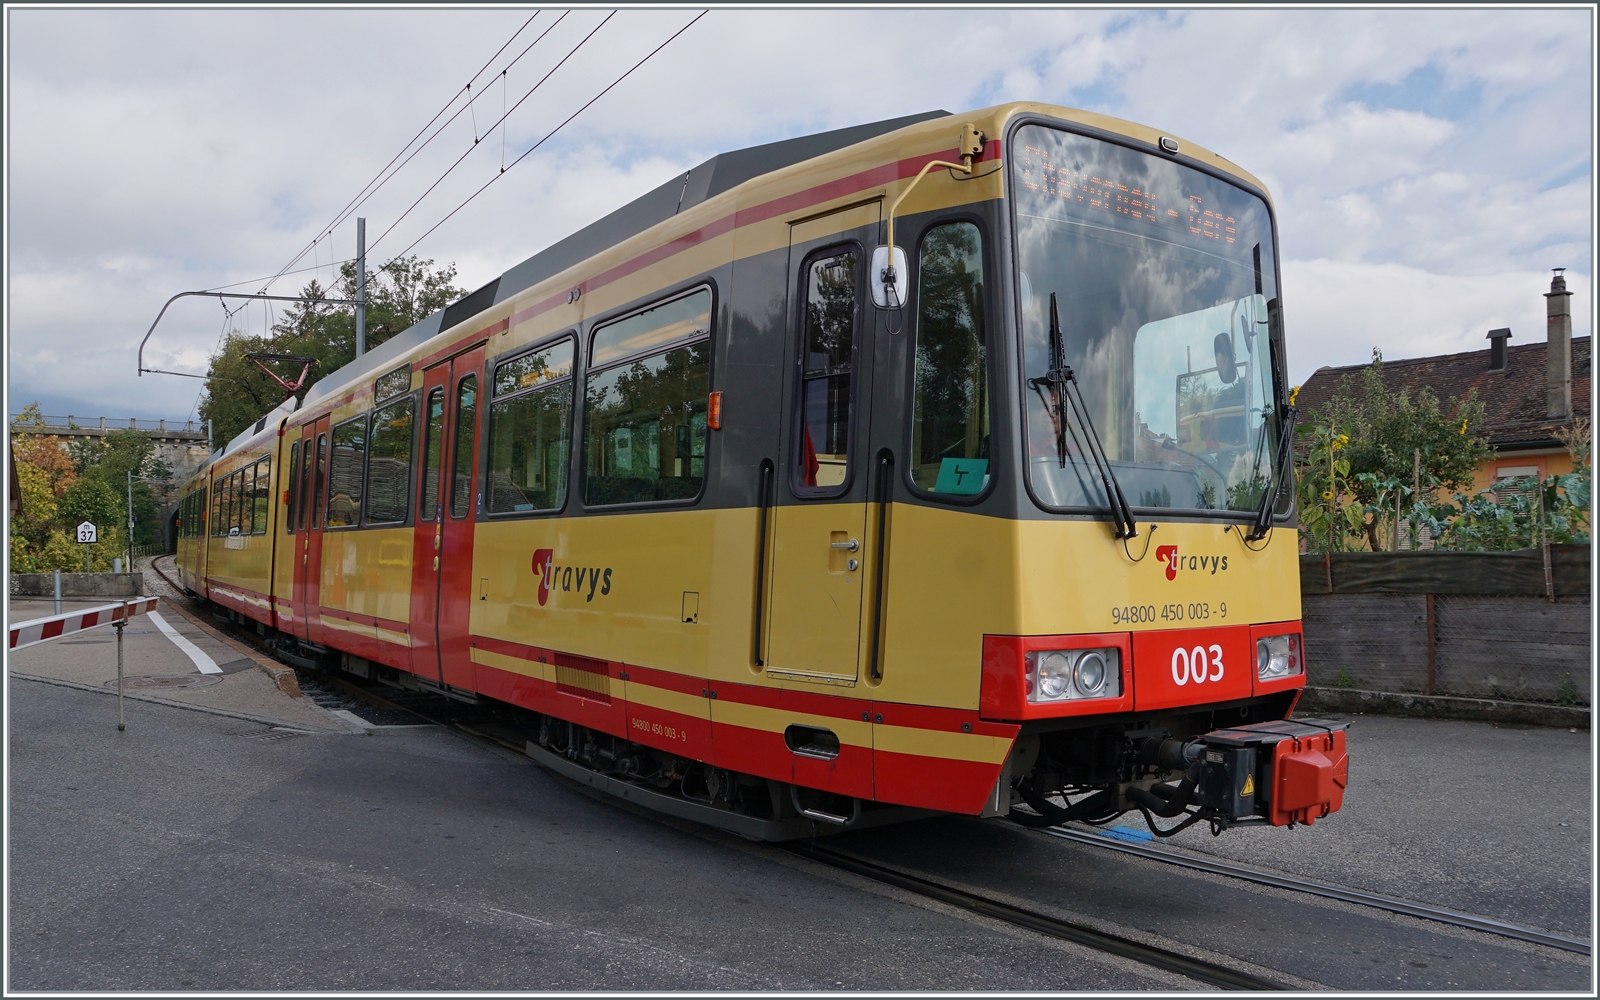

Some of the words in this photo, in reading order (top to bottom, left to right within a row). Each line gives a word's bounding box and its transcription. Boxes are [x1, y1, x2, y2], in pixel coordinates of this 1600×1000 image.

[477, 492, 482, 506] 2
[80, 530, 93, 541] 37
[1170, 548, 1228, 576] travys
[543, 554, 613, 603] travys
[1111, 605, 1156, 625] 94800
[1161, 603, 1184, 621] 450
[1188, 602, 1210, 620] 003
[1220, 601, 1227, 618] 9
[1171, 644, 1224, 686] 003
[631, 717, 650, 732] 94800
[651, 723, 663, 736] 450
[664, 726, 676, 739] 003
[681, 730, 687, 742] 9
